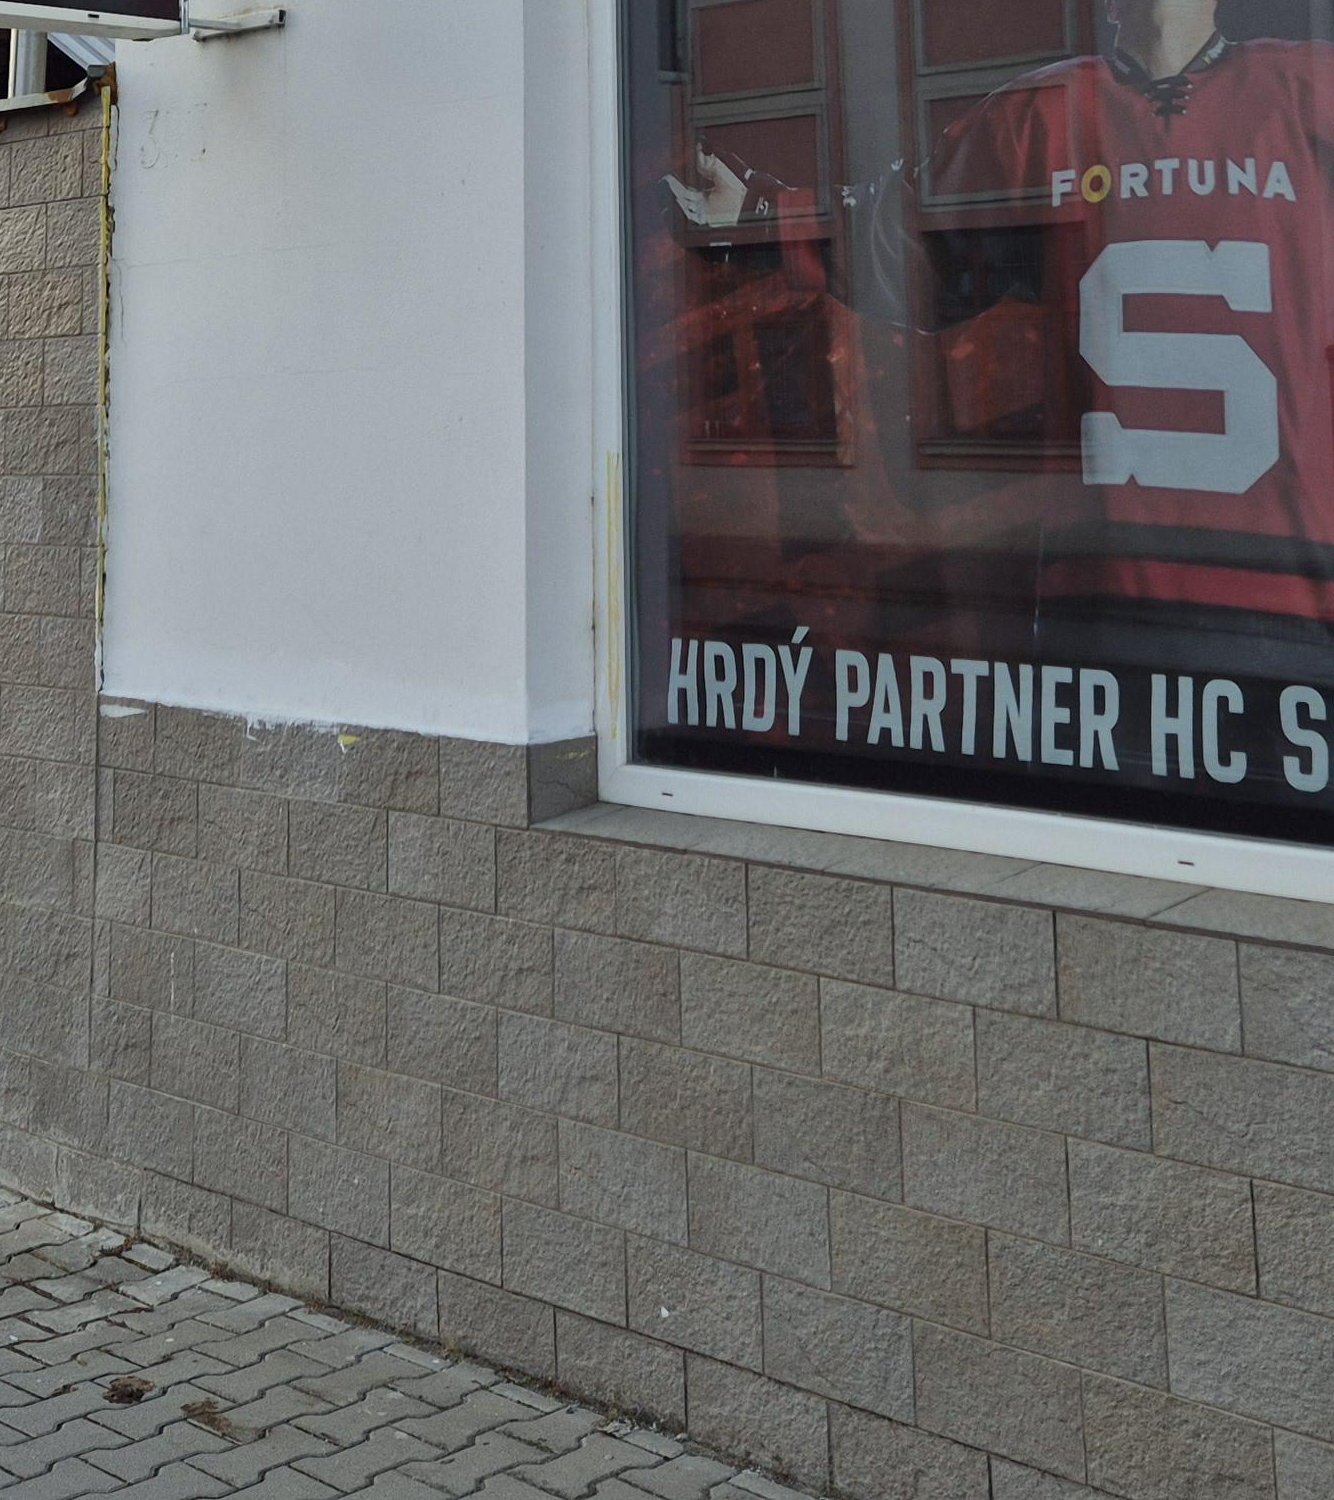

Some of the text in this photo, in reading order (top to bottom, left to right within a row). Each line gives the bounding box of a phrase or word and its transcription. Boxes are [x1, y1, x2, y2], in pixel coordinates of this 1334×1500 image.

[1051, 158, 1297, 207] FORTUNA
[1079, 239, 1280, 495] S
[668, 626, 813, 736] HRDÝ
[835, 649, 1120, 770] PARTNER
[1150, 674, 1247, 784] HC
